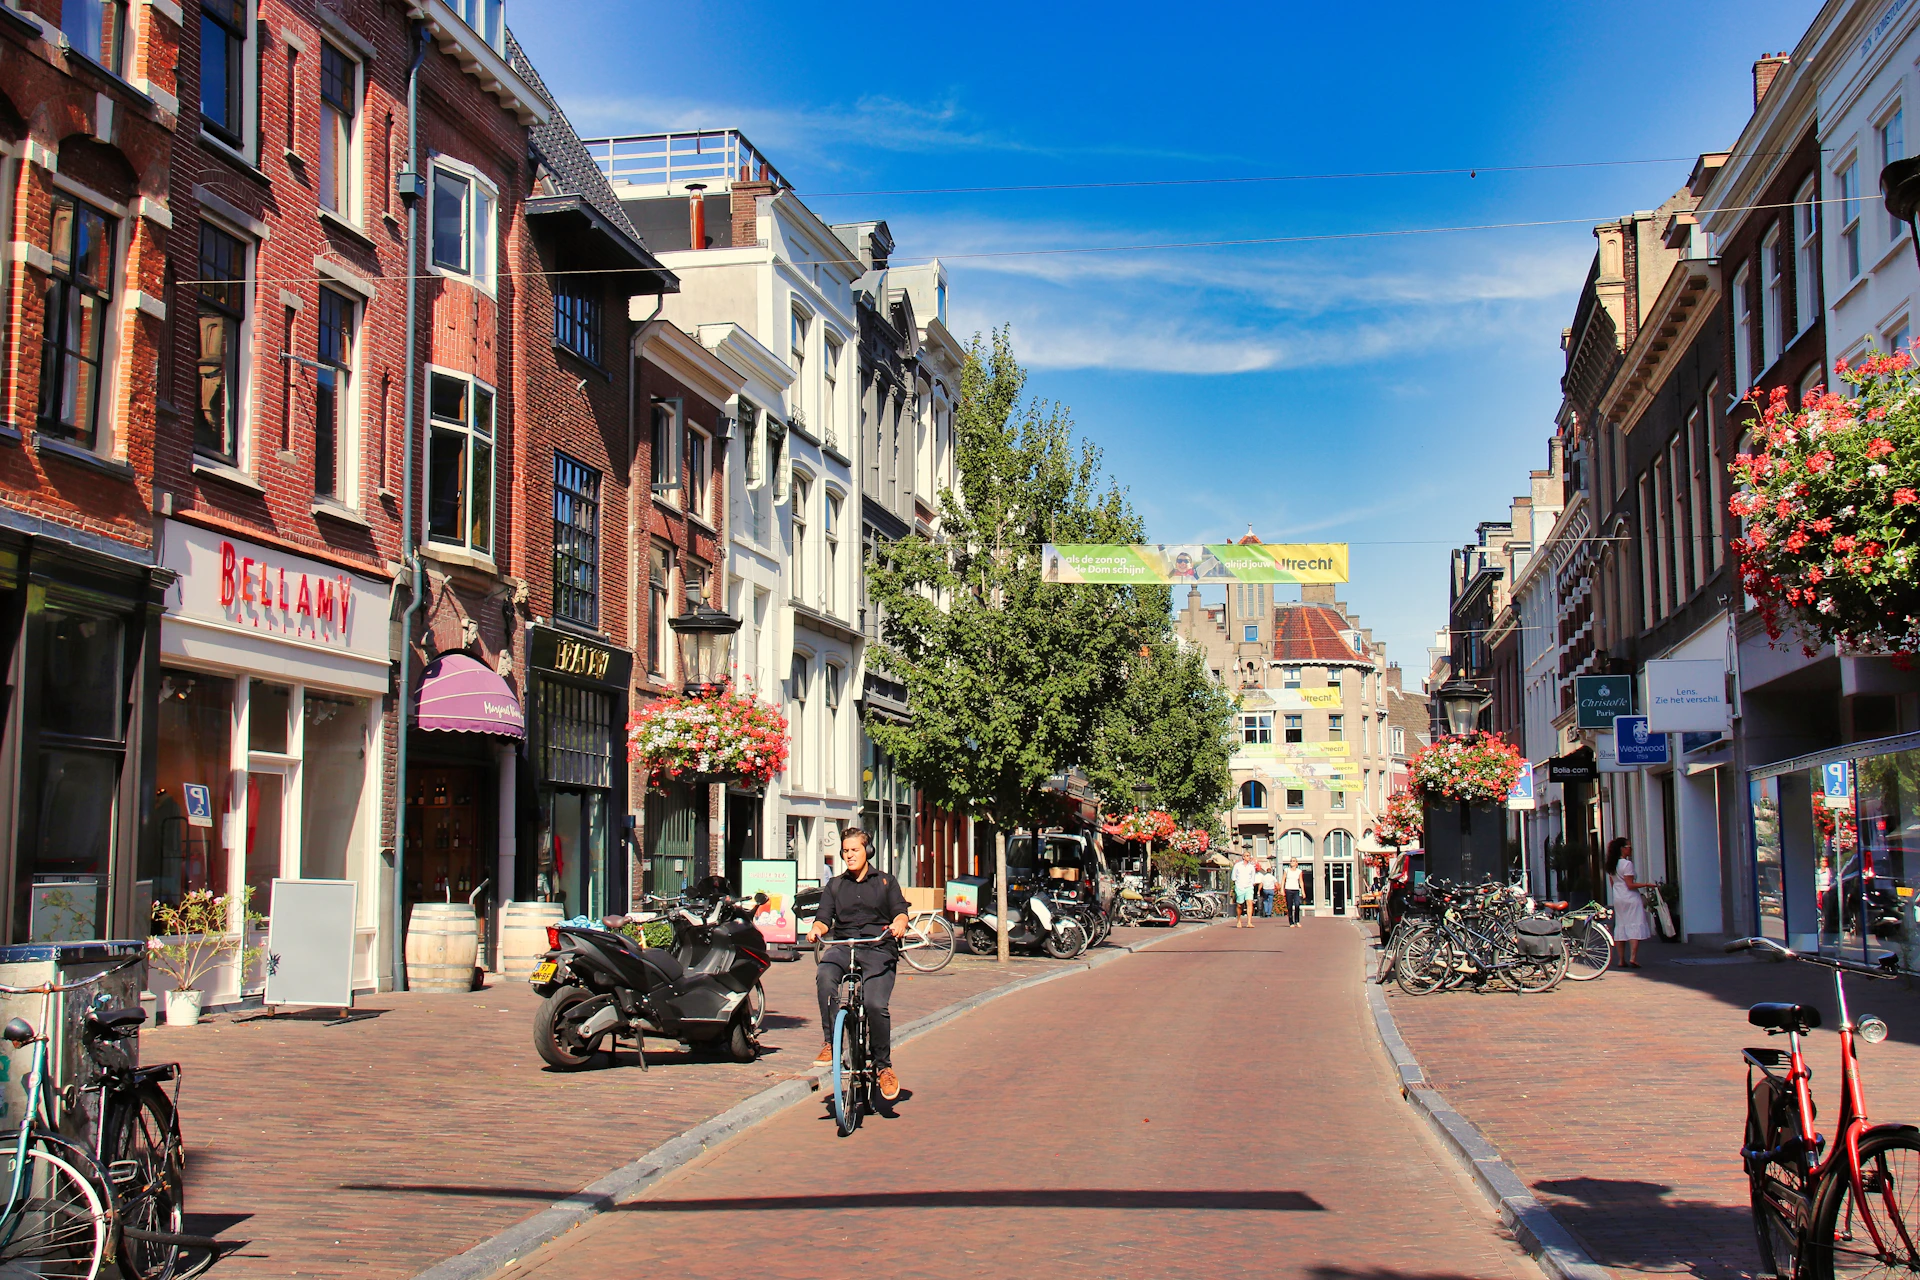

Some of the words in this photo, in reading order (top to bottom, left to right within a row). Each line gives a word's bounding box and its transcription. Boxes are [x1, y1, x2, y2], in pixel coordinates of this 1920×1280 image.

[1066, 555, 1080, 564] als
[1081, 555, 1093, 564] de
[1114, 557, 1127, 567] op
[1225, 560, 1248, 569] altijd
[1249, 561, 1271, 570] jouw
[1275, 557, 1333, 570] Utrecht
[1074, 565, 1086, 573] de
[1088, 565, 1111, 574] Dom
[1112, 565, 1145, 576] schijnt
[219, 540, 352, 634] BELLAMY
[1301, 694, 1332, 702] Utrecht
[1581, 698, 1627, 707] Christofle
[1655, 696, 1668, 704] Zie
[1619, 745, 1664, 753] Wedgwood
